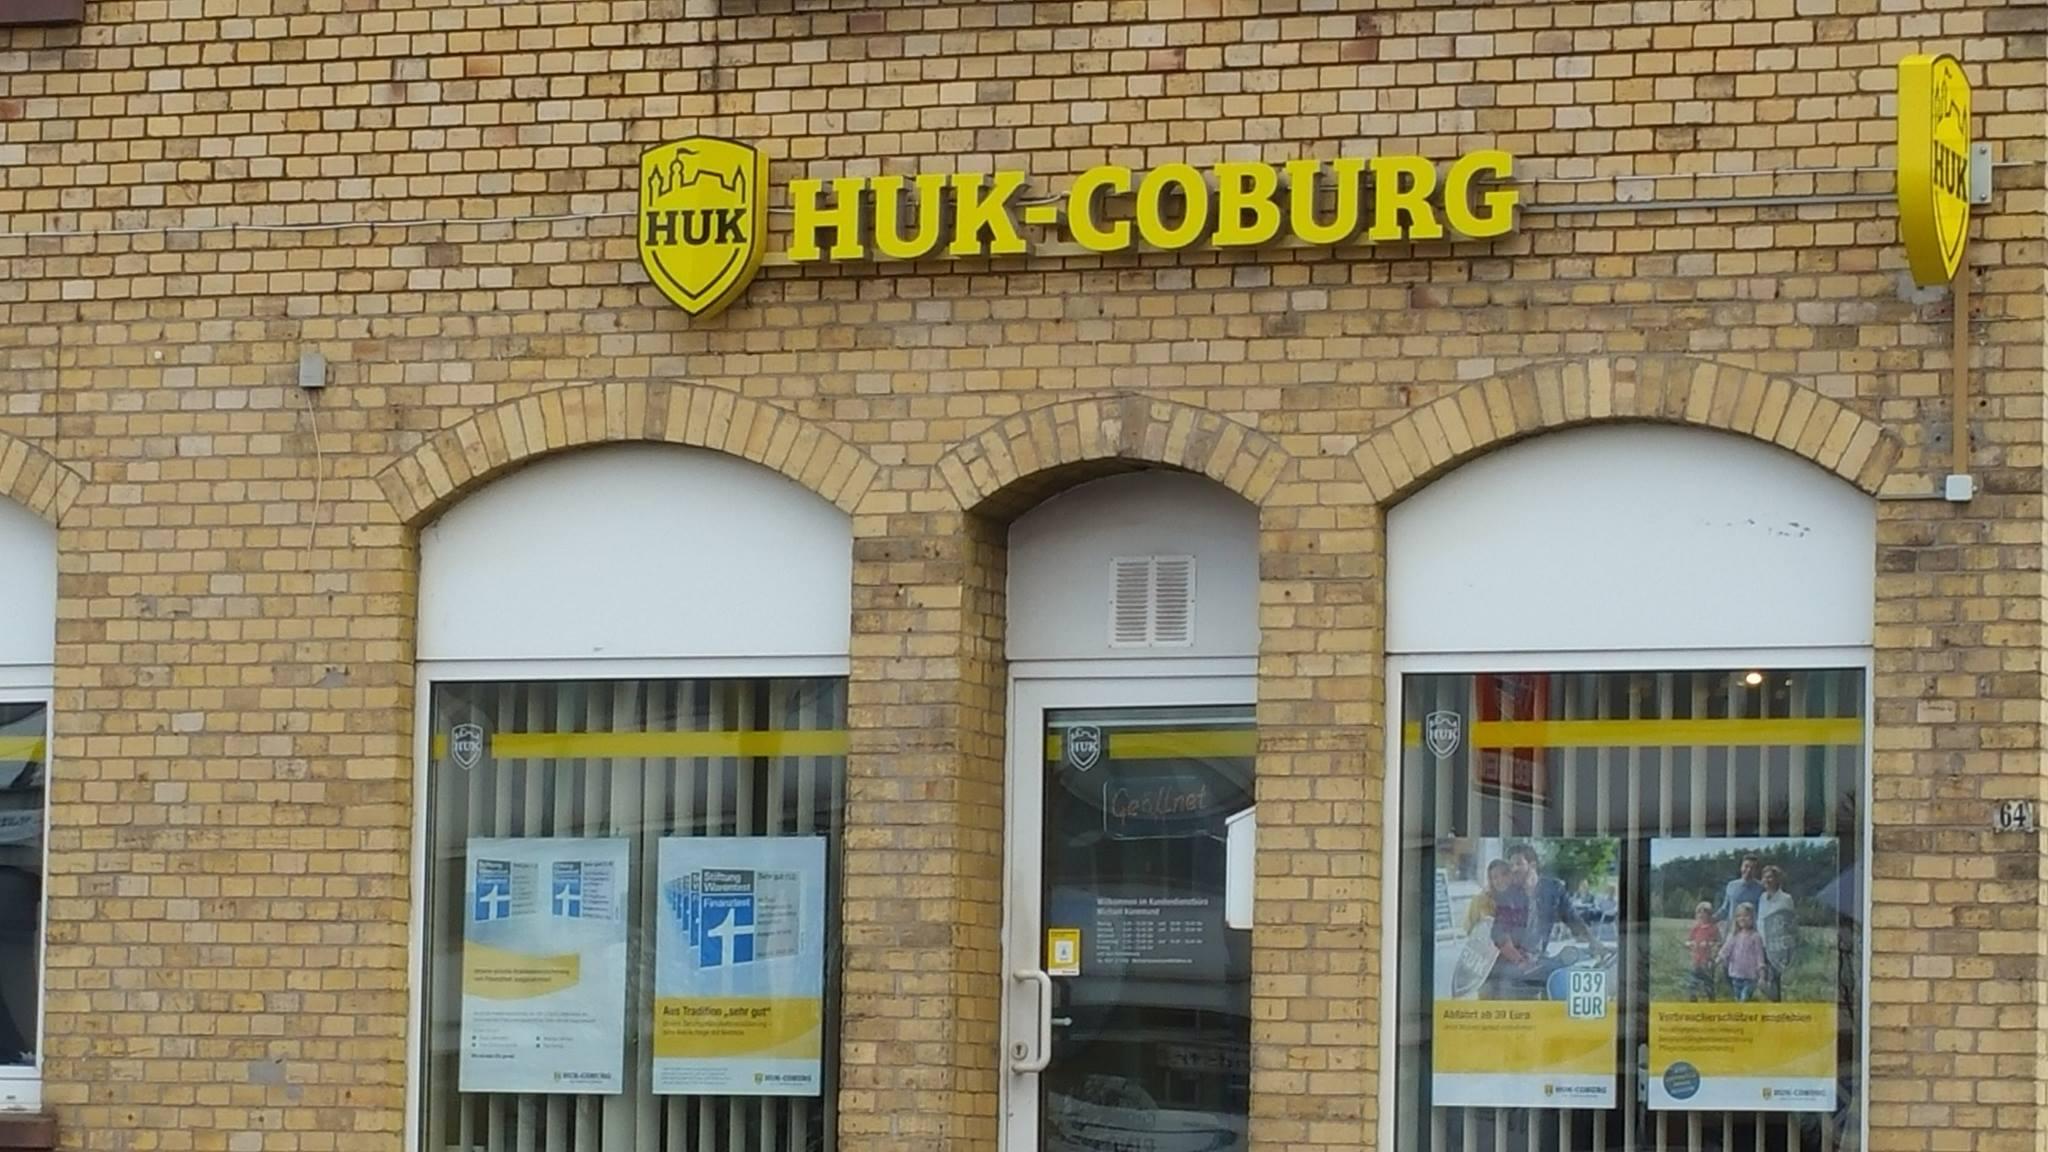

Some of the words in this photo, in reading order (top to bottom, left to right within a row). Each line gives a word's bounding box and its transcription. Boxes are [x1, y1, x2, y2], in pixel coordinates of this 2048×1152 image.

[1934, 140, 1968, 203] HUK
[788, 149, 1520, 262] HUK-COBURG
[645, 207, 748, 247] HUK
[1071, 740, 1099, 753] HUK
[2000, 802, 2027, 828] 64
[703, 870, 742, 884] Stiftung
[1572, 972, 1604, 993] 039
[663, 1006, 680, 1017] Aus
[683, 1006, 722, 1017] Tradition
[1481, 1010, 1492, 1020] ab
[1509, 1010, 1531, 1020] Euro
[1572, 996, 1603, 1016] EUR
